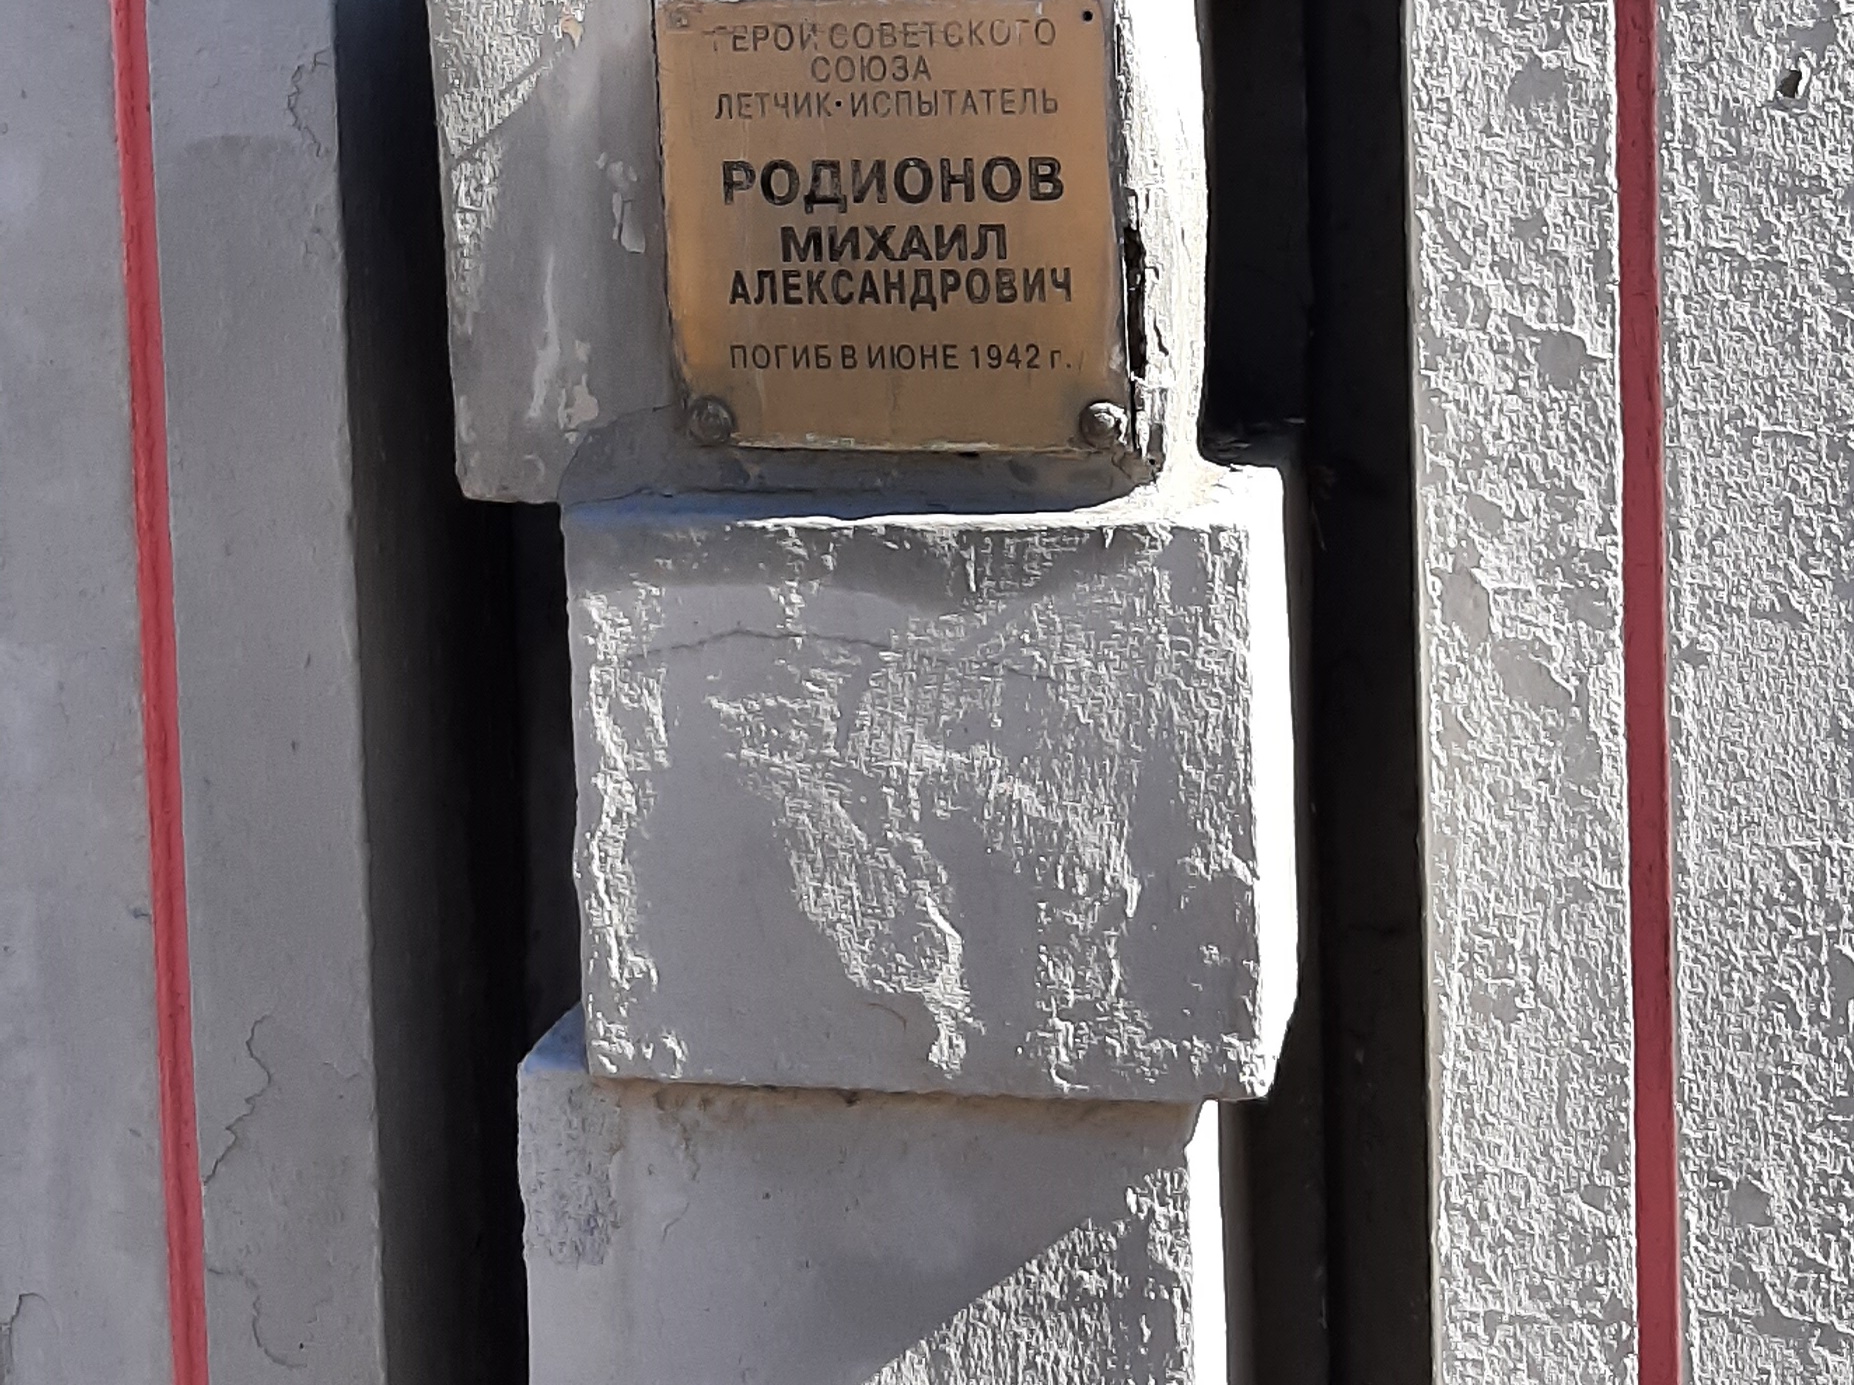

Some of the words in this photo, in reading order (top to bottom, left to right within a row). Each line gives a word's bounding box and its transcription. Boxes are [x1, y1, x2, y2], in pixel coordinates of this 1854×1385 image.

[829, 17, 1057, 52] СОВЕТСКОГО
[810, 54, 933, 84] СОЮЗА
[721, 155, 1065, 214] РОДИОНОВ
[780, 223, 1008, 263] МИХАИЛ
[728, 266, 1073, 312] АЛЕКСАНДРОВИЧ
[730, 344, 832, 370] ПОГИБ
[840, 345, 858, 369] В
[867, 344, 960, 370] ИЮНЕ
[971, 343, 1041, 370] 1942
